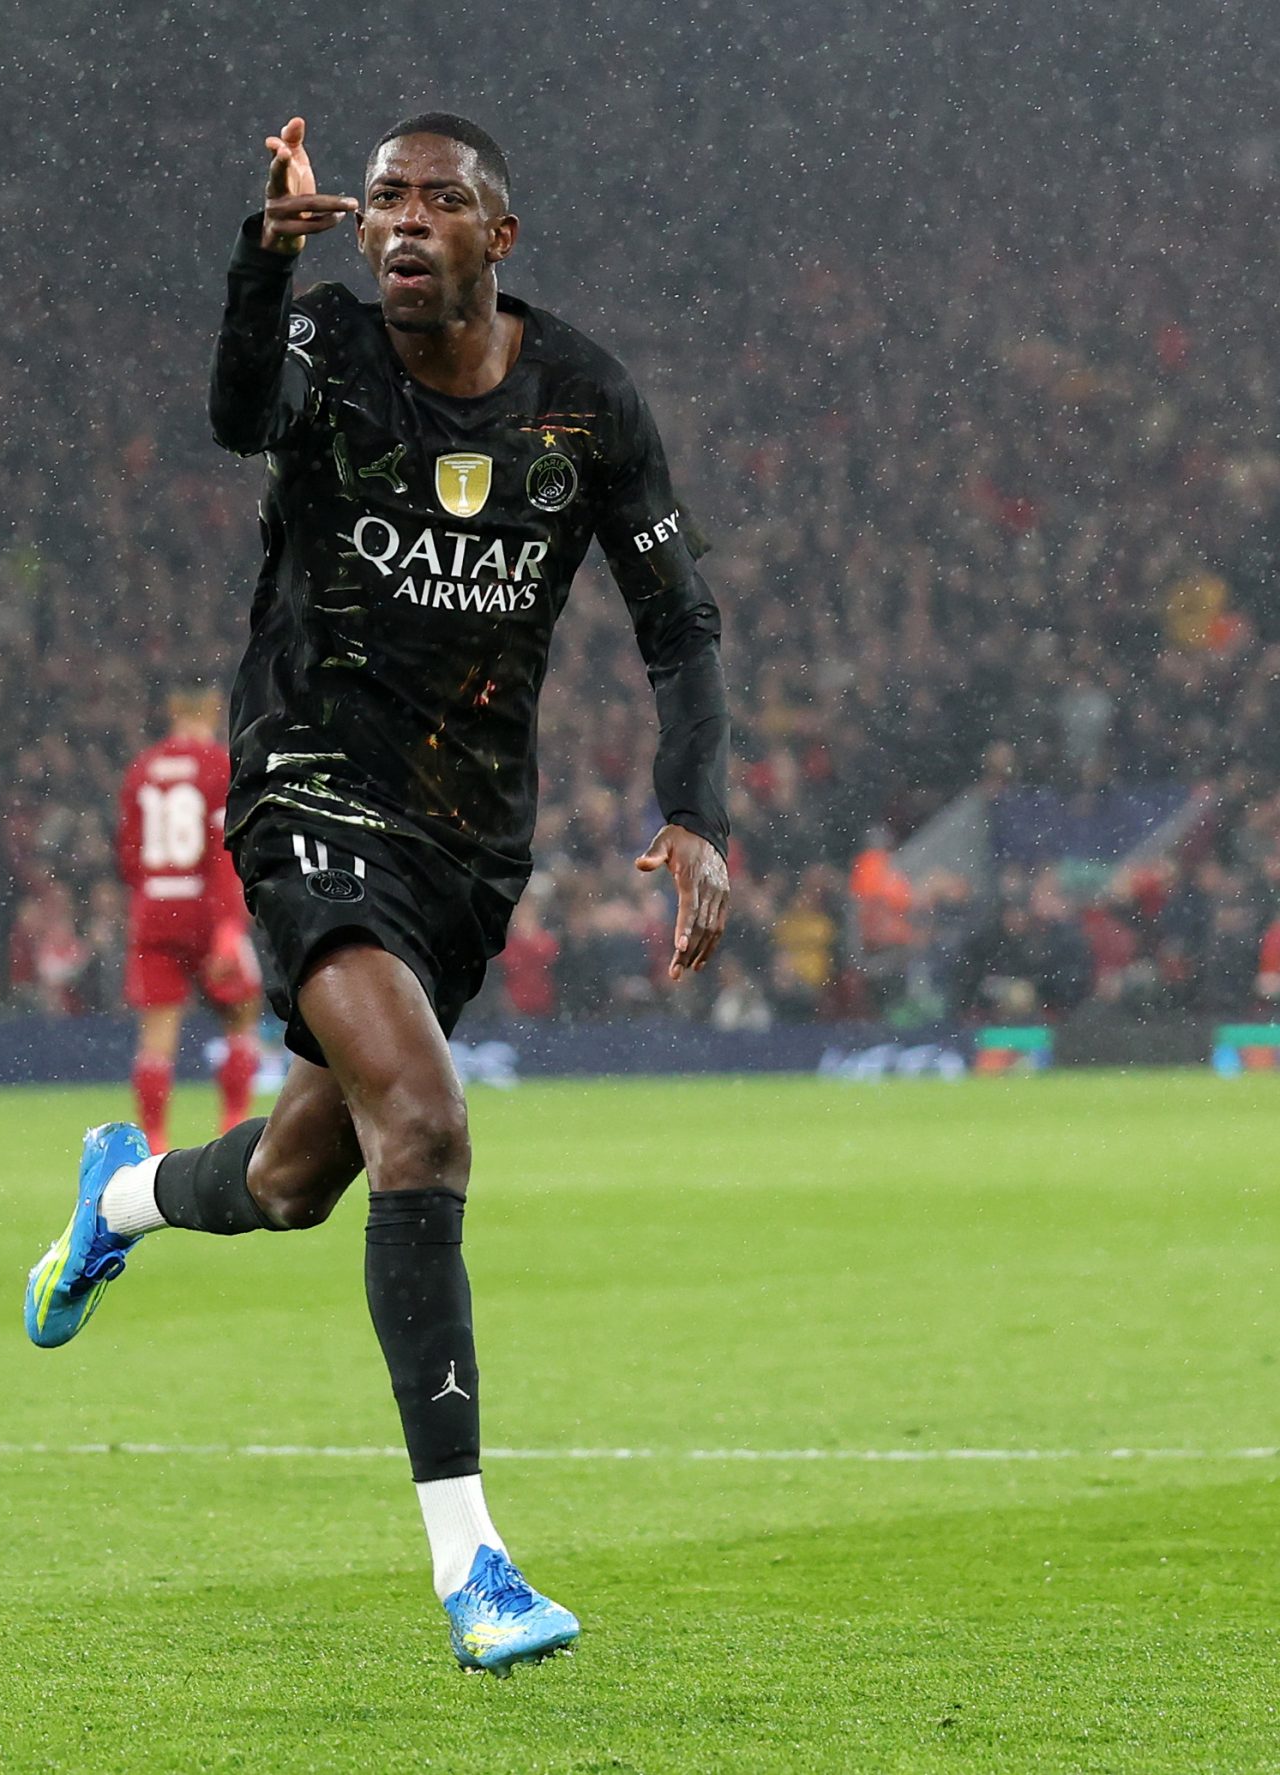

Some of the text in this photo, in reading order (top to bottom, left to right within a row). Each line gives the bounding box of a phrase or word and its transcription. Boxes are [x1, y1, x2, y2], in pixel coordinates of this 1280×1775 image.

[536, 458, 566, 472] PARIS
[353, 515, 550, 583] QATAR
[633, 508, 680, 553] BEY
[393, 575, 539, 613] AIRWAYS
